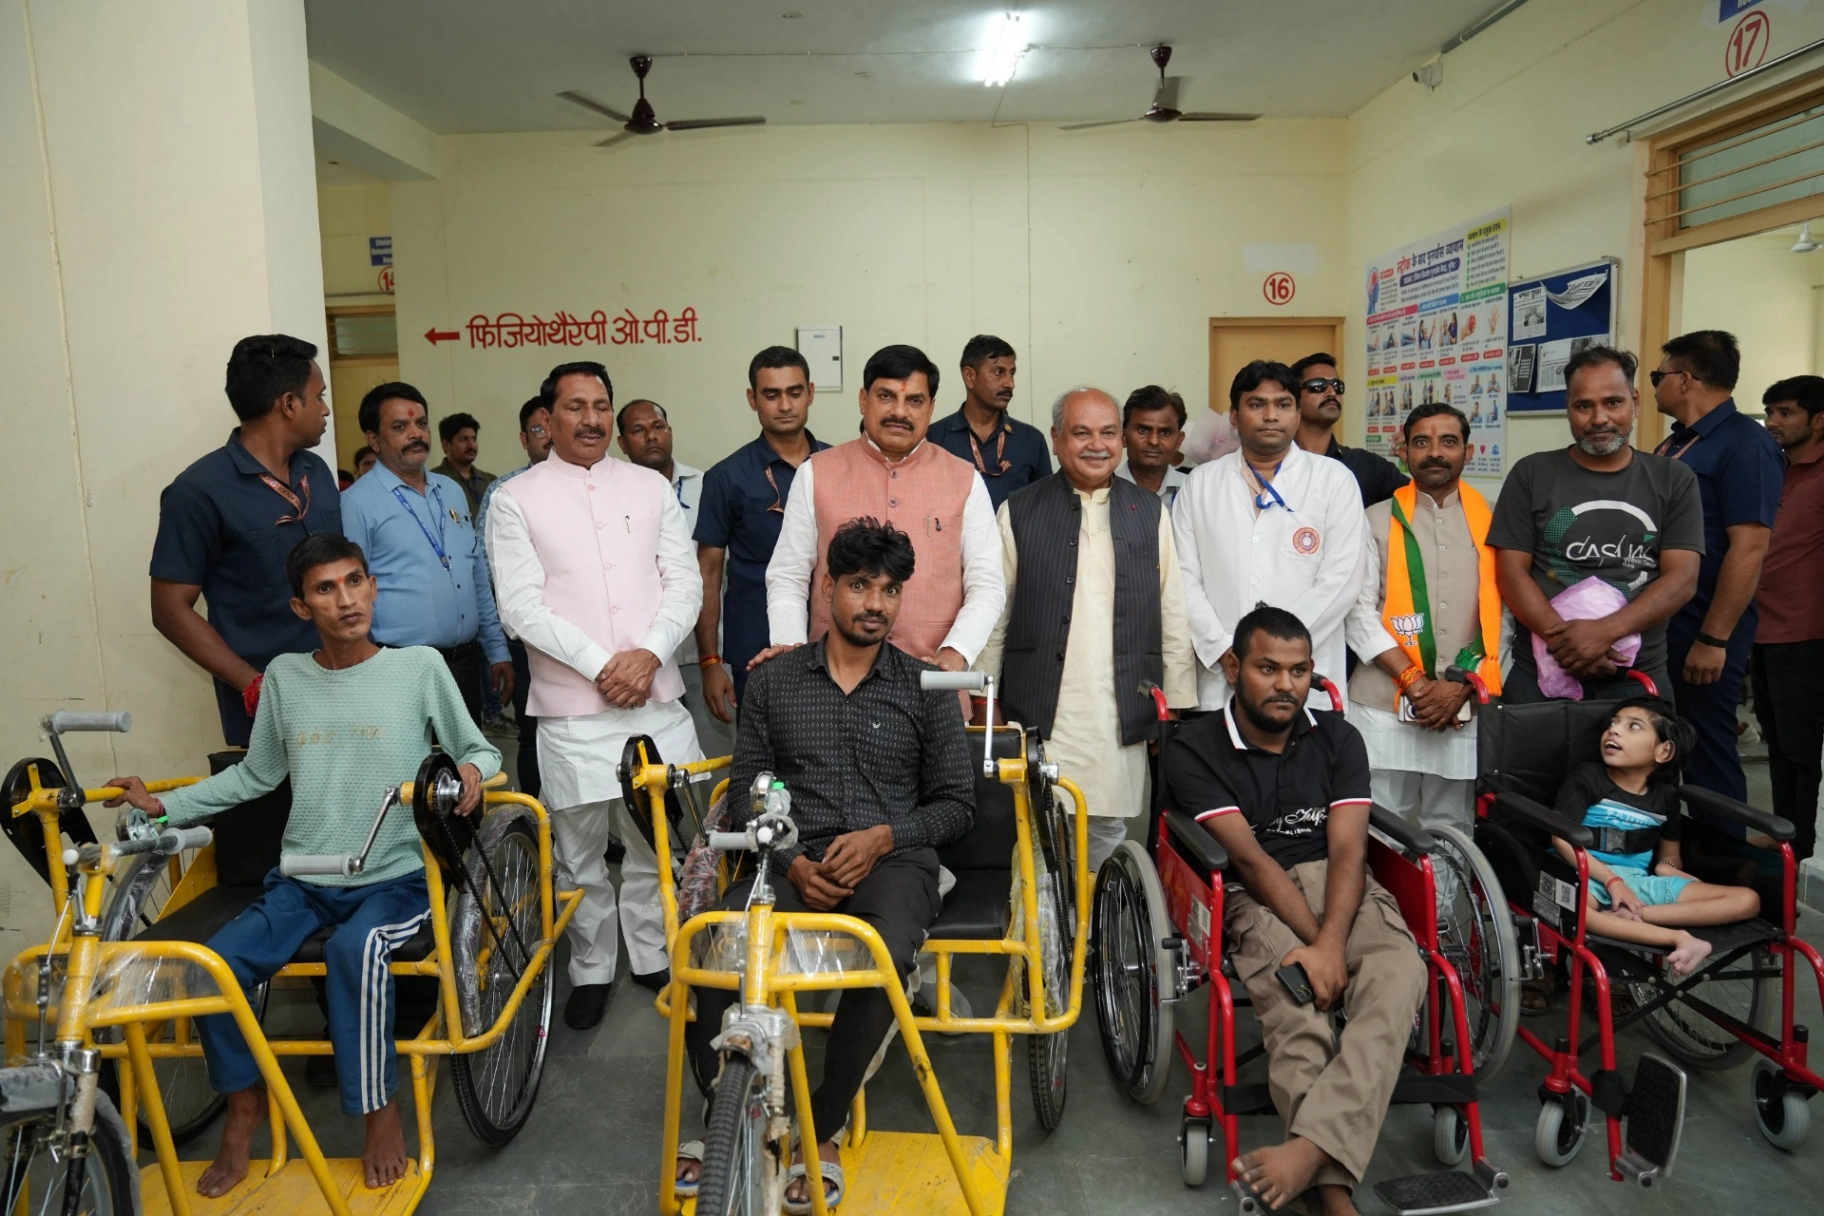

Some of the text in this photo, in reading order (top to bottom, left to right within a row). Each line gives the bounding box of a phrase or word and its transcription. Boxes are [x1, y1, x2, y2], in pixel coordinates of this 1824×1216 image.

[1733, 19, 1762, 72] 17
[1412, 253, 1417, 267] के
[1269, 277, 1290, 300] 16
[466, 311, 607, 349] फिजियोथैरेपी
